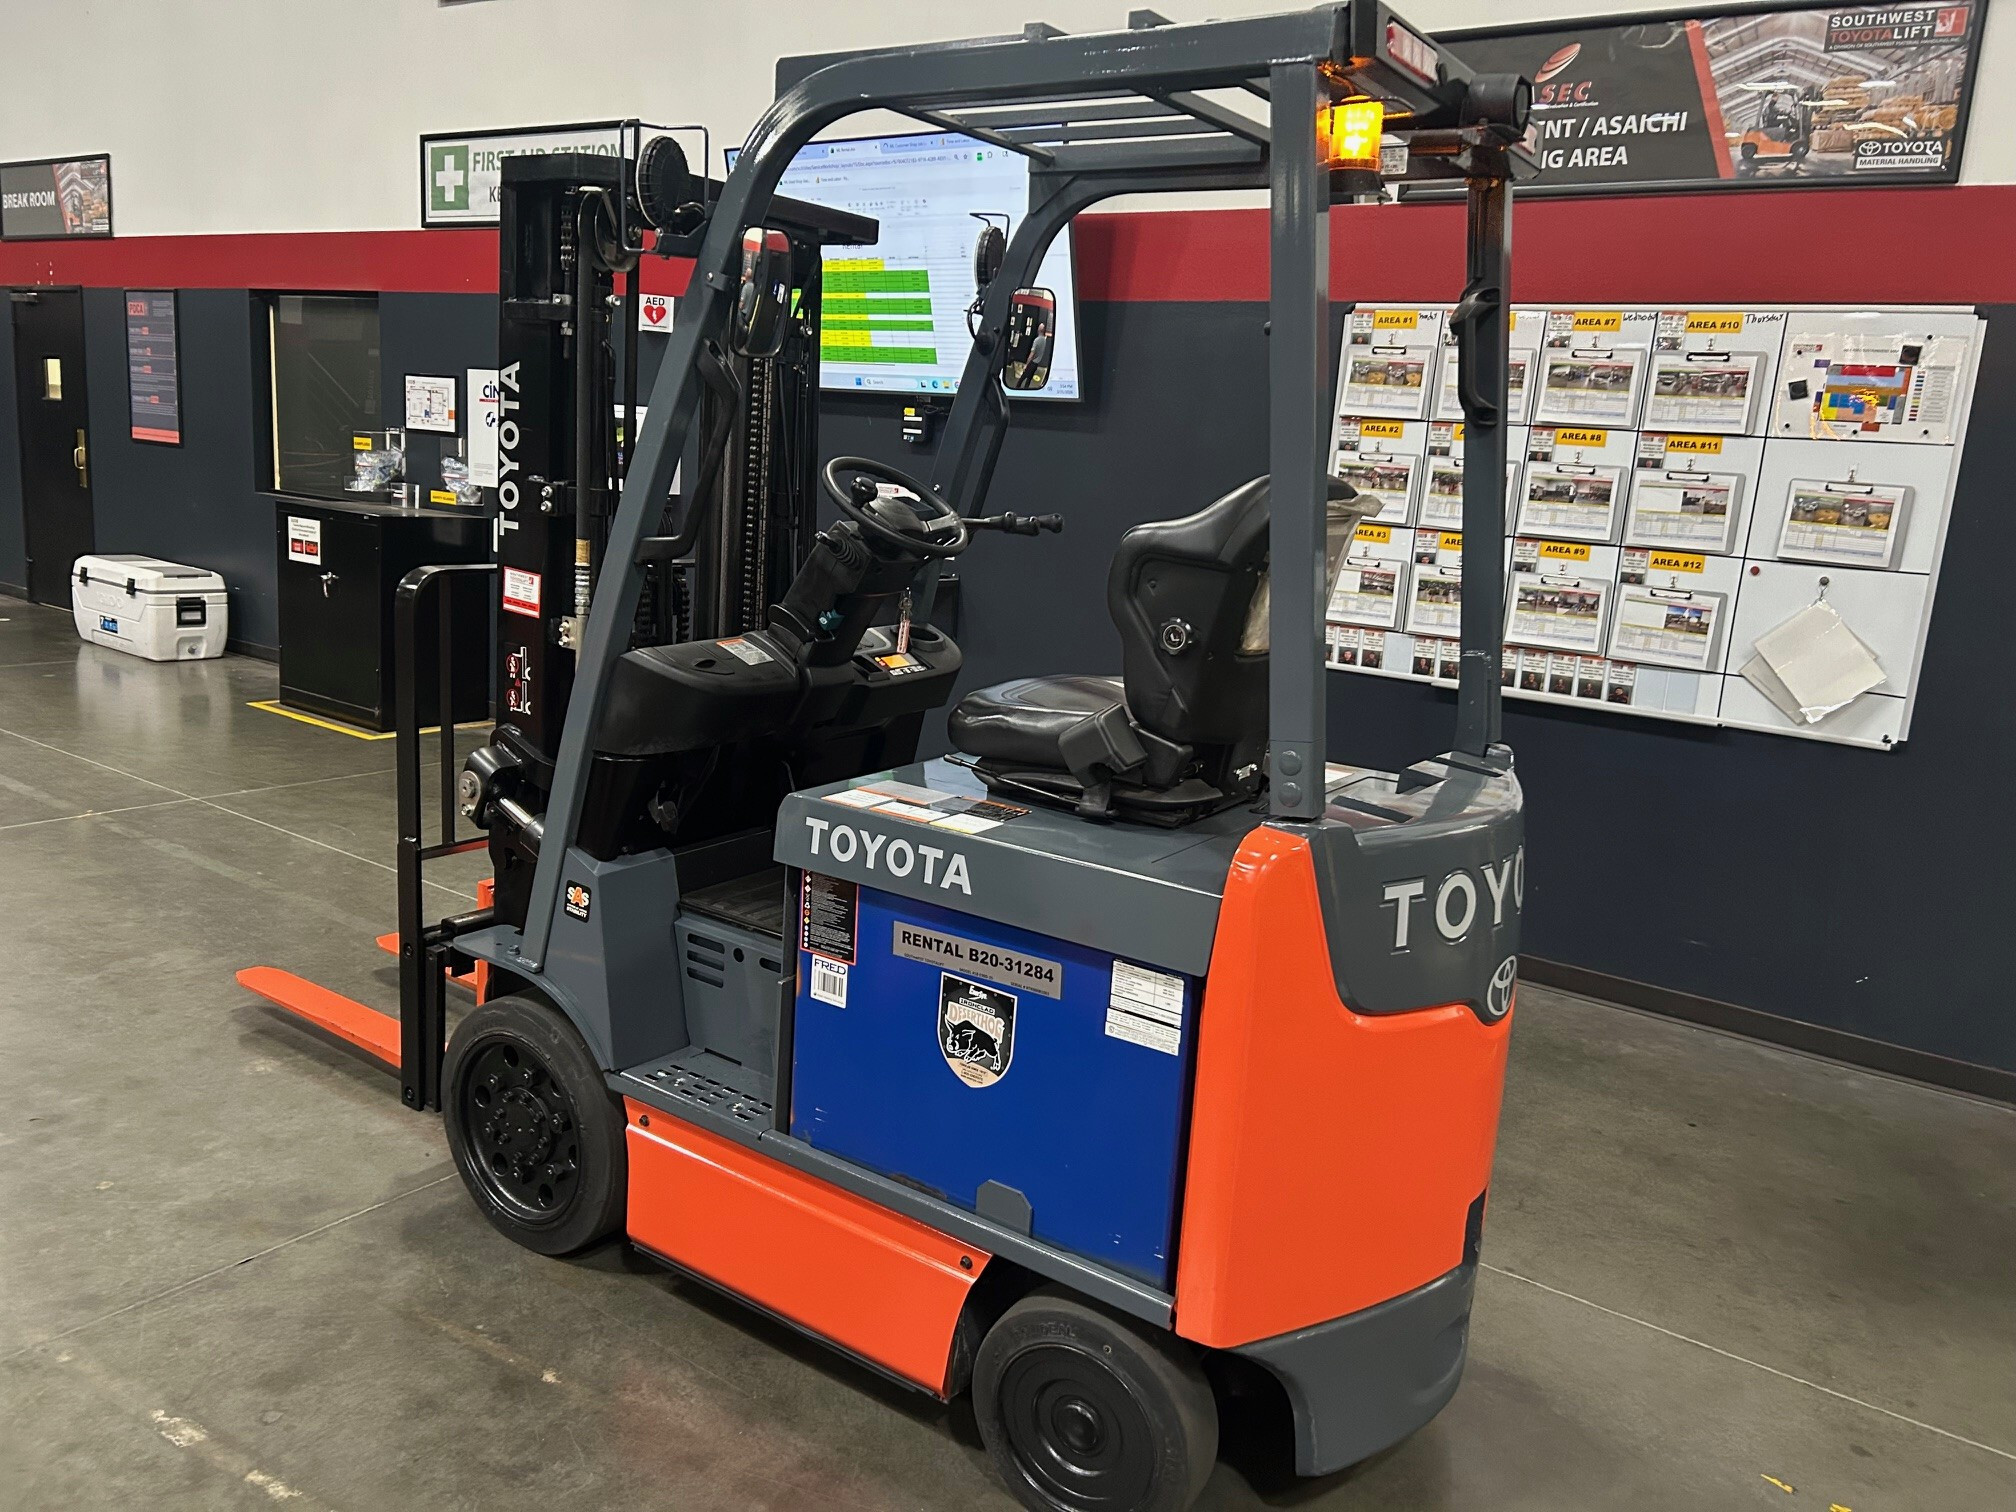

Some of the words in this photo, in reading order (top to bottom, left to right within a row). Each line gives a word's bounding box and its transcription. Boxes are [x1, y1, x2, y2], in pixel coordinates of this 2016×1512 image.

[1830, 9, 1936, 28] SOUTHWEST
[1830, 25, 1933, 43] TOYOTALIFT
[1578, 117, 1590, 138] /
[1592, 111, 1688, 136] ASAICHI
[1882, 141, 1943, 154] TOYOTA
[1567, 146, 1628, 168] AREA
[1859, 158, 1897, 166] MATERIAL
[1898, 156, 1939, 165] HANDLING
[3, 192, 29, 209] BREAK
[30, 190, 56, 207] ROOM
[646, 296, 665, 306] AED
[1377, 316, 1400, 325] AREA
[1402, 316, 1413, 325] #1
[1575, 317, 1602, 326] AREA
[1604, 317, 1616, 326] #7
[1688, 320, 1717, 329] AREA
[1719, 320, 1739, 329] #10
[1364, 424, 1387, 433] AREA
[1388, 425, 1399, 434] #2
[1560, 432, 1588, 441] AREA
[1589, 433, 1602, 442] #8
[499, 361, 520, 536] TOYOTA
[1669, 440, 1698, 449] AREA
[1700, 441, 1719, 450] #11
[1376, 530, 1387, 539] #3
[1444, 537, 1462, 545] ARE
[1545, 545, 1571, 554] AREA
[1573, 546, 1586, 556] #9
[1652, 557, 1680, 567] AREA
[1683, 560, 1702, 569] #12
[805, 816, 972, 896] TOYOTA
[566, 886, 590, 908] SAS
[1383, 845, 1524, 948] TOYO
[902, 930, 964, 959] RENTAL
[968, 947, 1054, 983] B20-31284
[814, 958, 847, 975] FRED
[960, 998, 994, 1014] IRONCLAD
